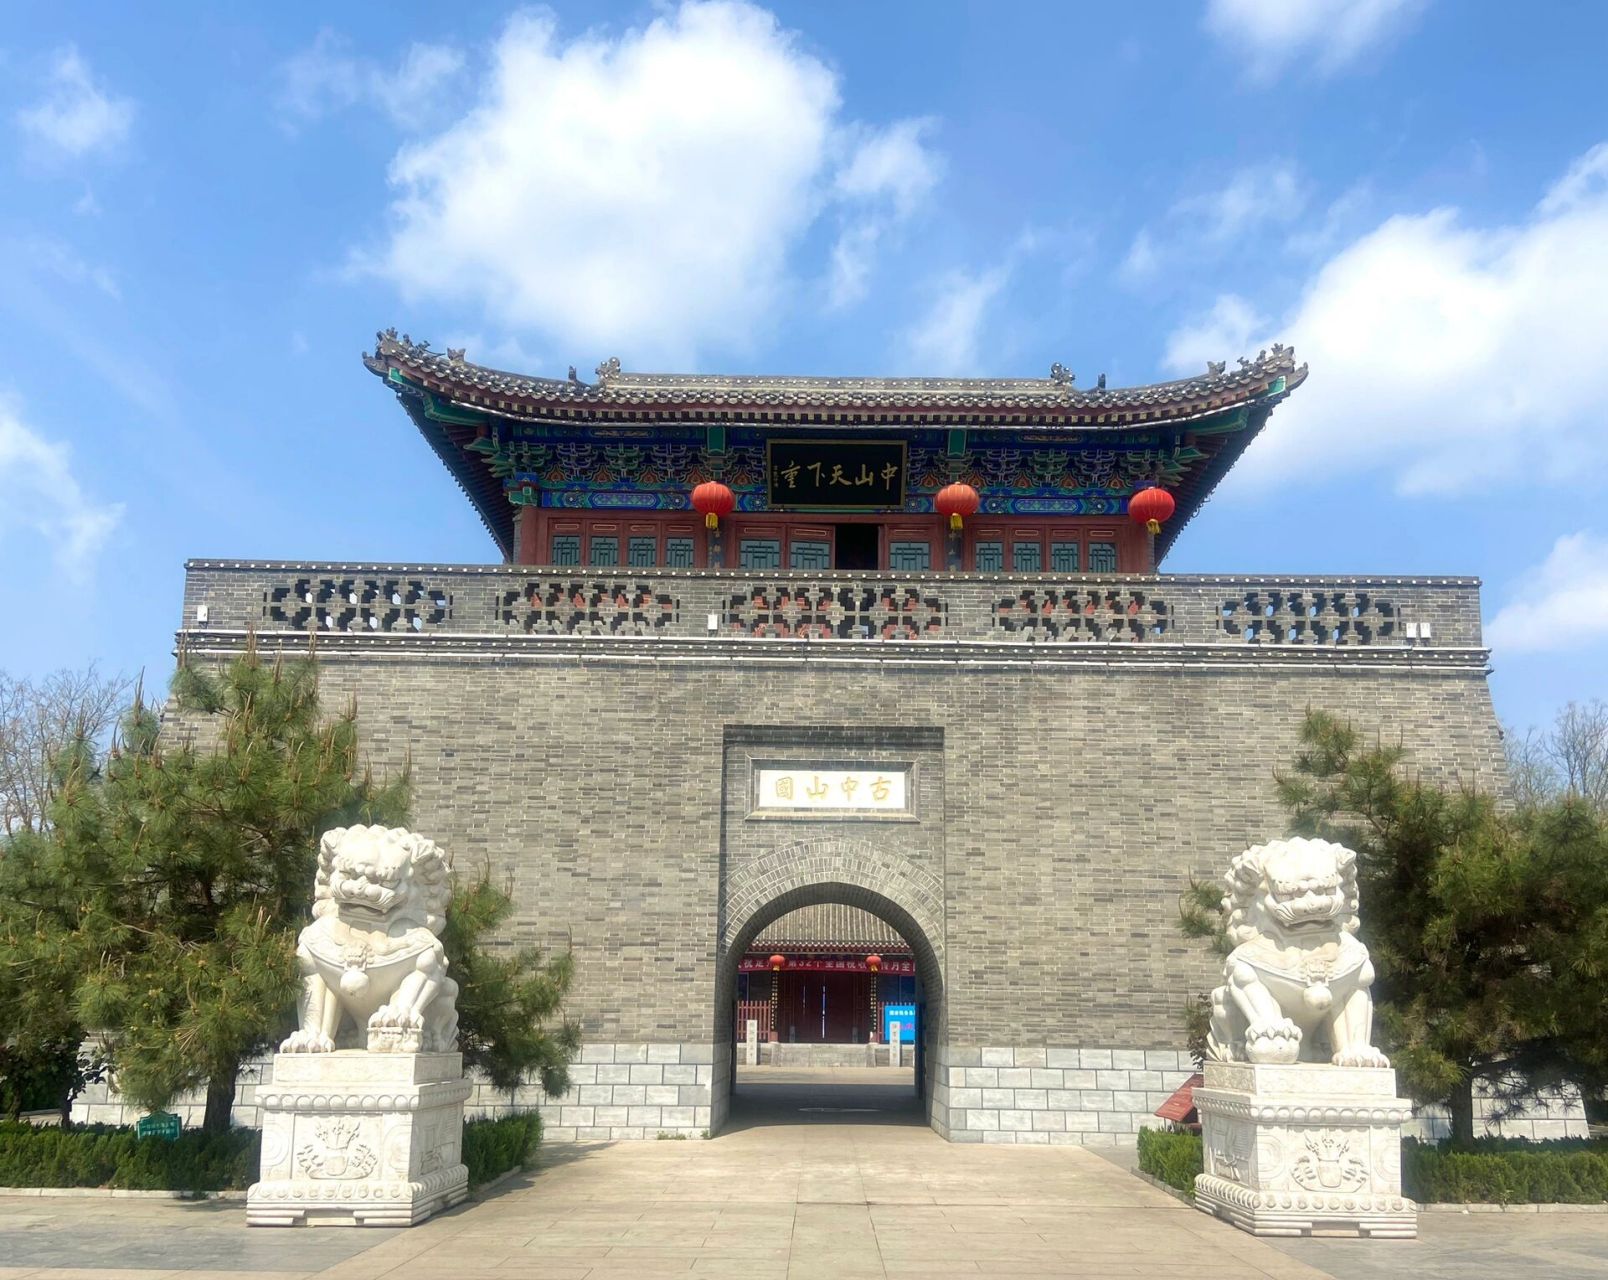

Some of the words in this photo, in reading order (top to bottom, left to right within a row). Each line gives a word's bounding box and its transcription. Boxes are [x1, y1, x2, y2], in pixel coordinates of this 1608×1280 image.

[781, 460, 898, 490] 中山天下重
[775, 775, 892, 801] 古中山國
